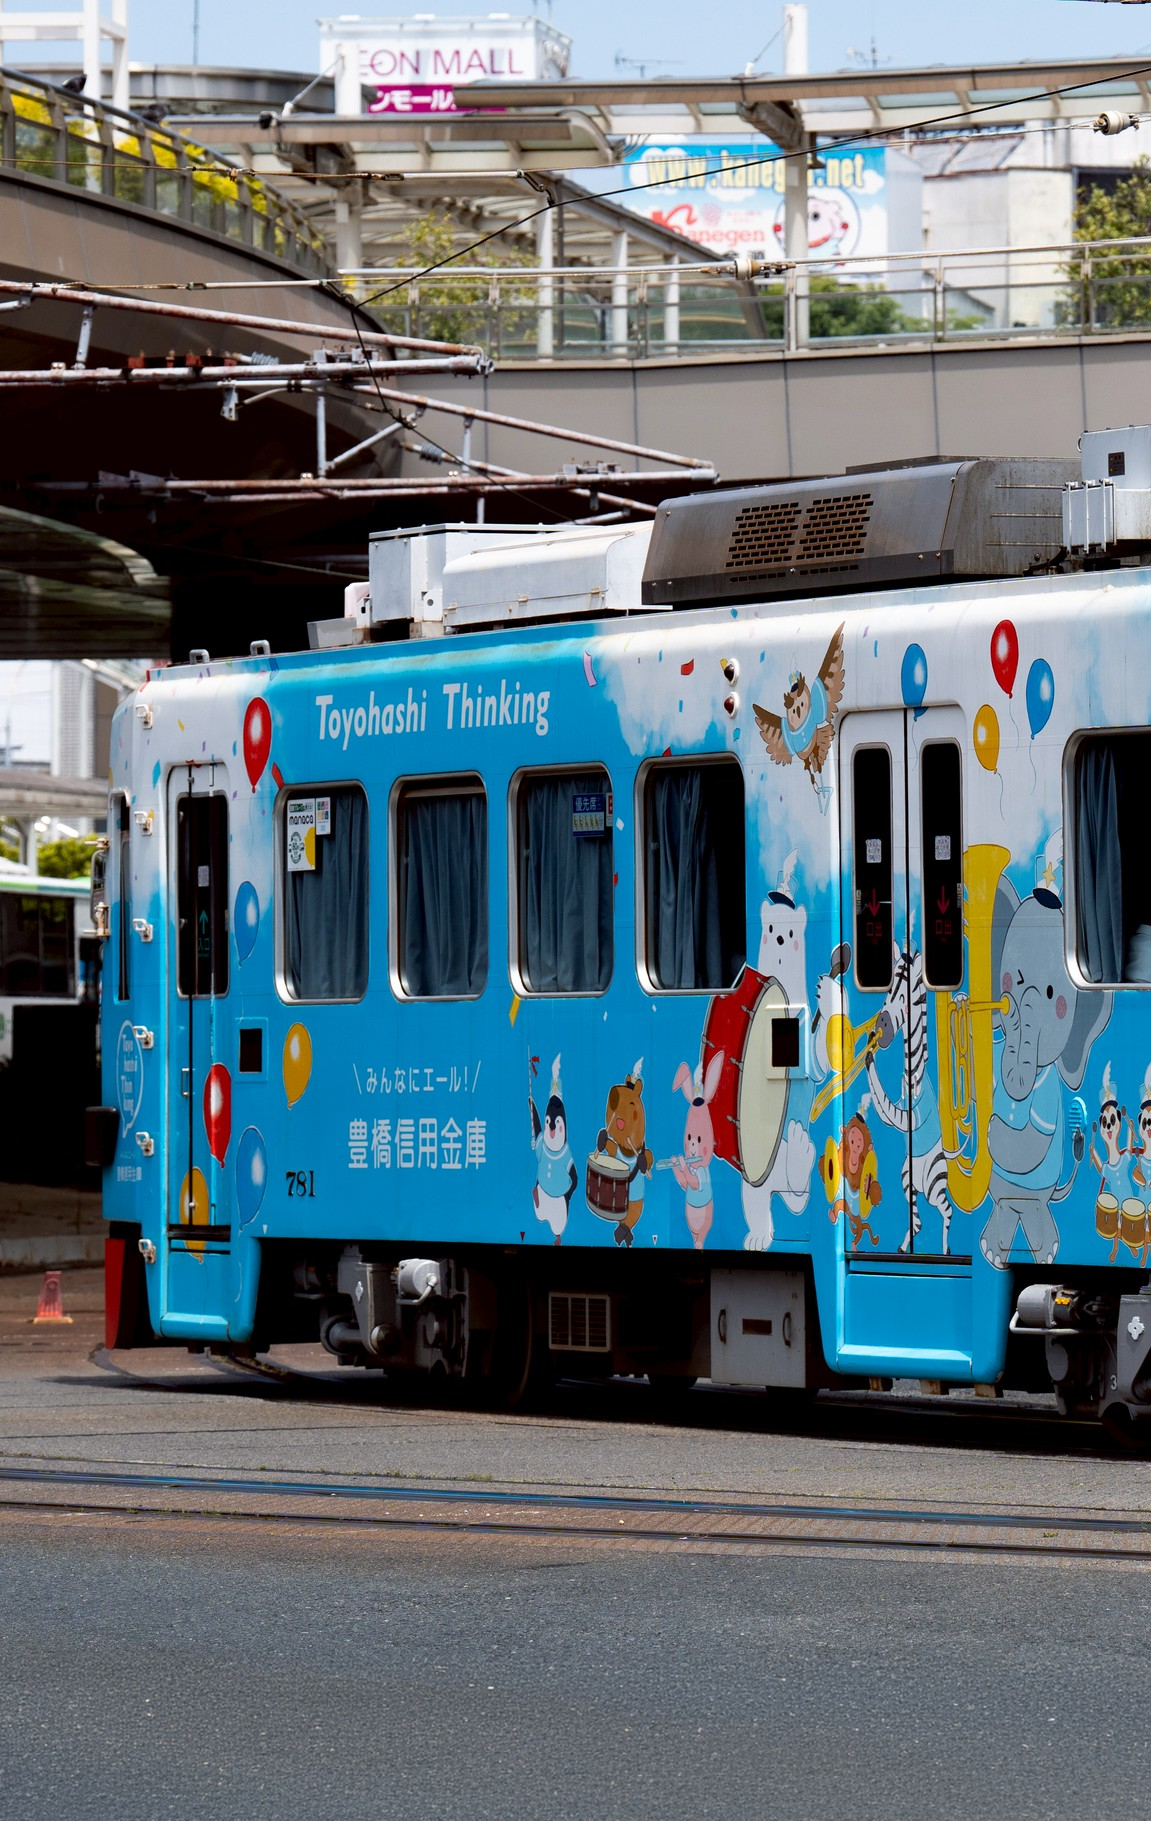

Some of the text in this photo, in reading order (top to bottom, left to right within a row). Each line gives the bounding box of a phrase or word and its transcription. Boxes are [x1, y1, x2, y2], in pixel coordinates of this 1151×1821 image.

[433, 49, 524, 75] MALL
[370, 89, 456, 111] ンモール
[646, 148, 864, 193] www.kaneg.net
[315, 678, 551, 751] Toyohashi Thinking
[288, 814, 314, 826] manaca
[347, 1116, 487, 1170] 豊橋信用金庫
[286, 1169, 316, 1198] 781
[1110, 1374, 1118, 1390] 3
